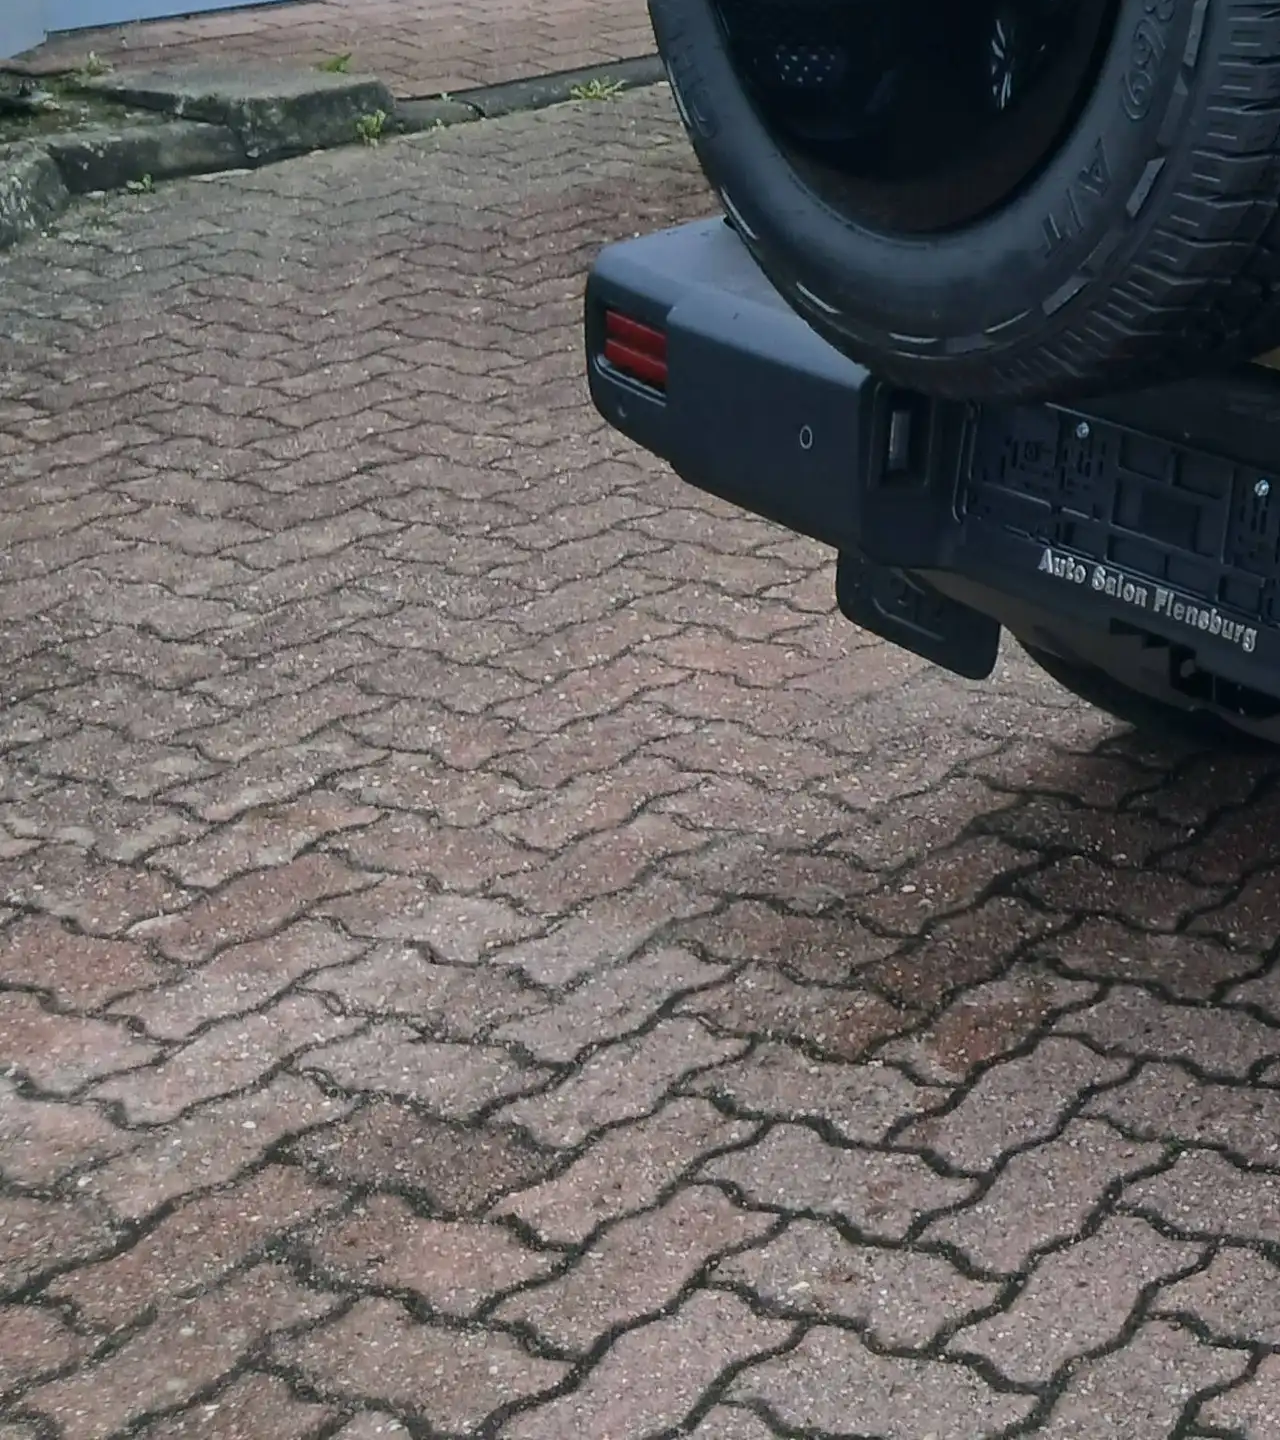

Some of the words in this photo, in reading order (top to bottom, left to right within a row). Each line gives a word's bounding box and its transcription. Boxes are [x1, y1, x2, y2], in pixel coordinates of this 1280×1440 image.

[1038, 547, 1087, 584] Auto
[1092, 565, 1148, 608] Salon
[1153, 587, 1258, 653] Flensburg
